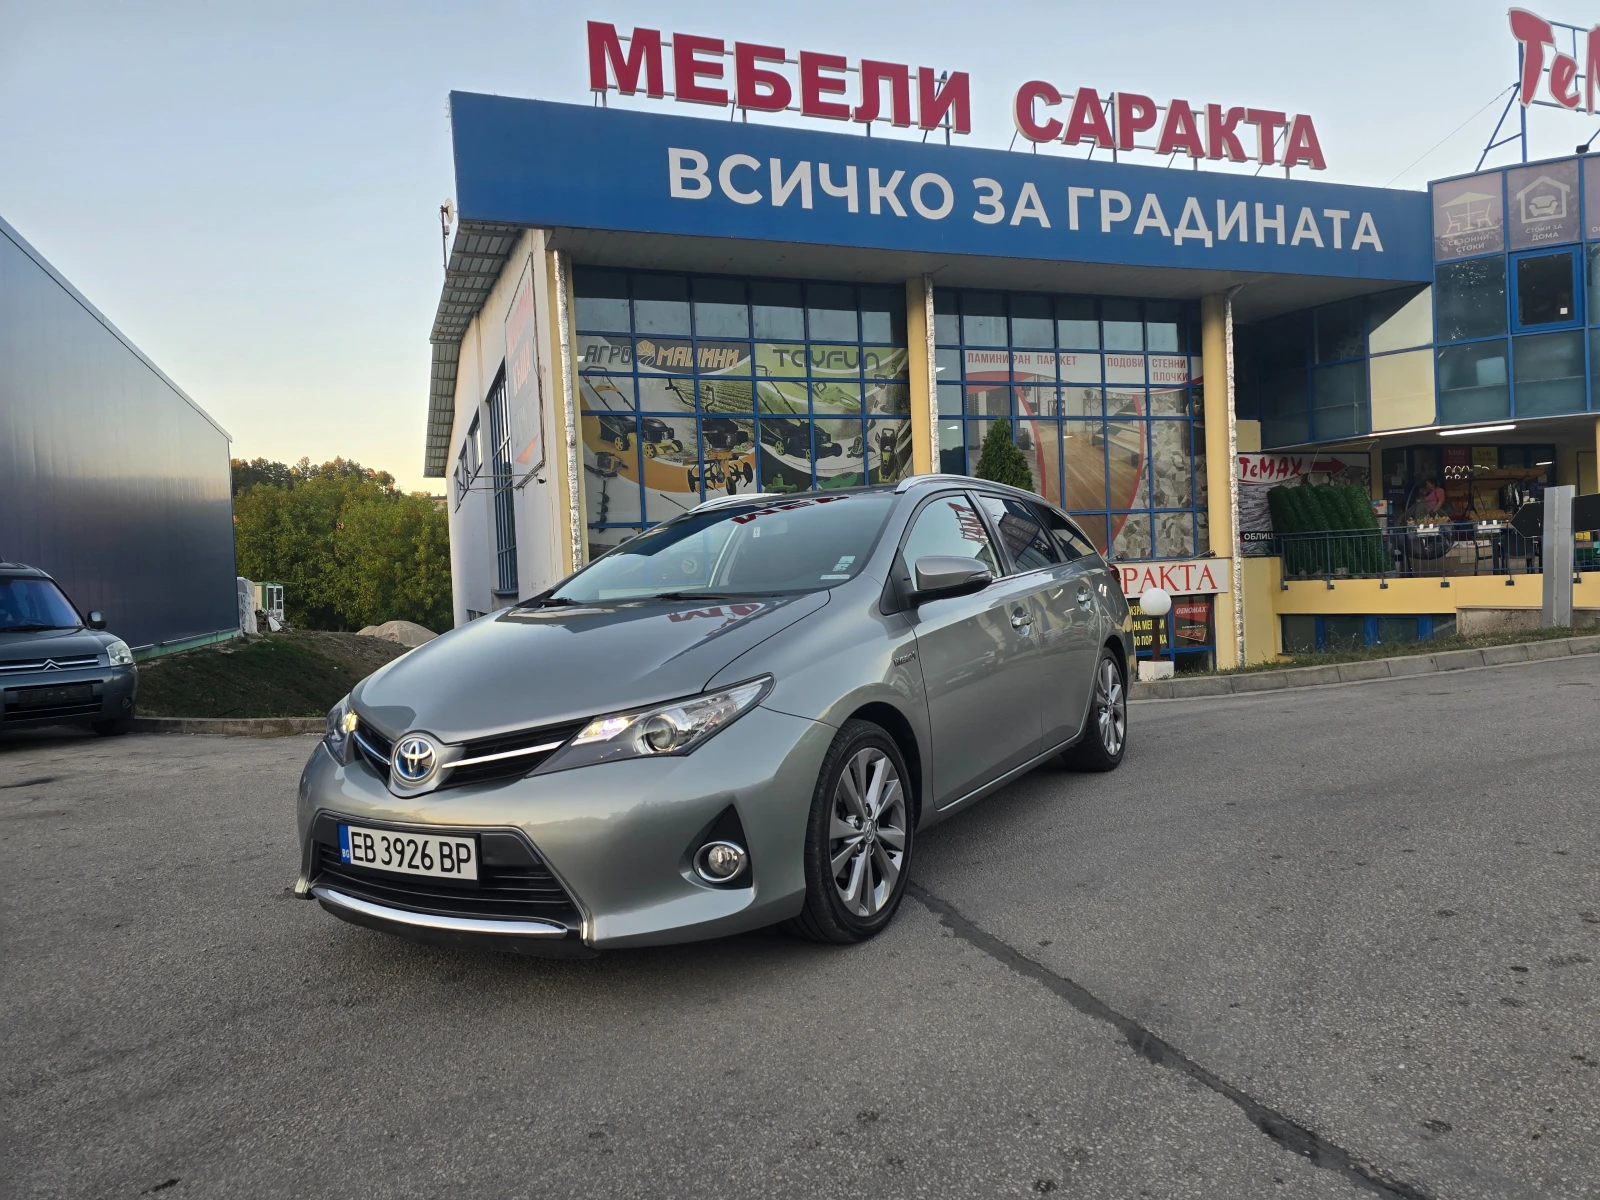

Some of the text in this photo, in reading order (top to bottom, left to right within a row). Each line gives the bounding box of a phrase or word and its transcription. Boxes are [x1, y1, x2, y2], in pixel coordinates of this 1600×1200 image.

[587, 20, 1327, 171] МЕБЕЛИ САРАКТА
[668, 147, 1384, 252] ВСИЧКО ЗА ГРАДИНАТА
[1525, 223, 1551, 234] СТОКИ
[1448, 234, 1490, 246] СЕЗОННИ
[1531, 231, 1560, 242] ДОМА
[1455, 243, 1485, 254] СТОКИ
[584, 344, 740, 369] АГРО МАШИНИ
[967, 352, 1077, 366] ЛАМИНИРАН ПАРКЕТ
[1107, 357, 1186, 369] ПОДОВИ СТЕННИ
[1153, 371, 1189, 383] ПЛОЧКИ
[1121, 564, 1218, 595] РАКТА
[341, 848, 351, 859] BG
[351, 831, 472, 874] EB 3926 BP
